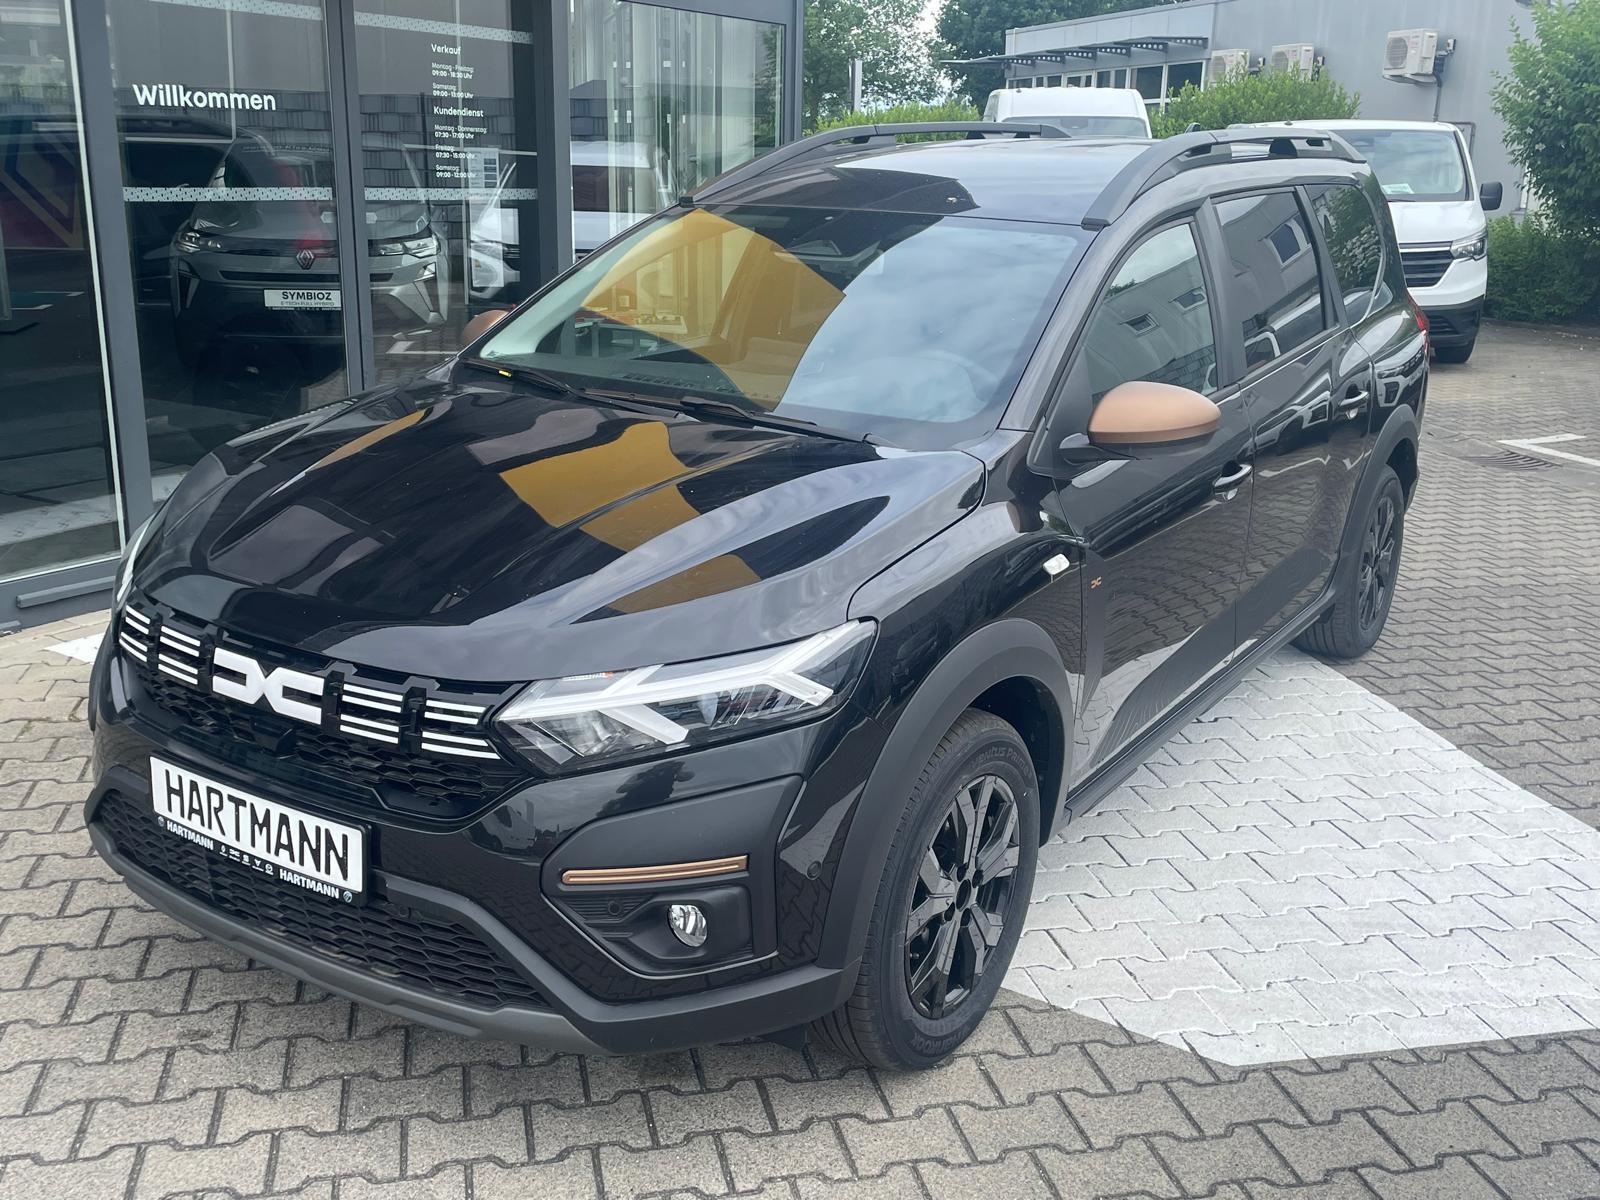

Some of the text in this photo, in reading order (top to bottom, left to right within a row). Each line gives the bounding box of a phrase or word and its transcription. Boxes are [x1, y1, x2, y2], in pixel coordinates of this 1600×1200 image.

[431, 43, 461, 55] Verkauf
[432, 62, 452, 71] Montag
[132, 84, 276, 111] Willkommen
[433, 106, 484, 117] Kundendienst
[434, 124, 455, 133] Montag
[282, 291, 332, 301] SYMBIOZ
[165, 769, 349, 882] HARTMANN
[166, 820, 214, 851] HARTMANN
[279, 867, 340, 900] HARTMANN
